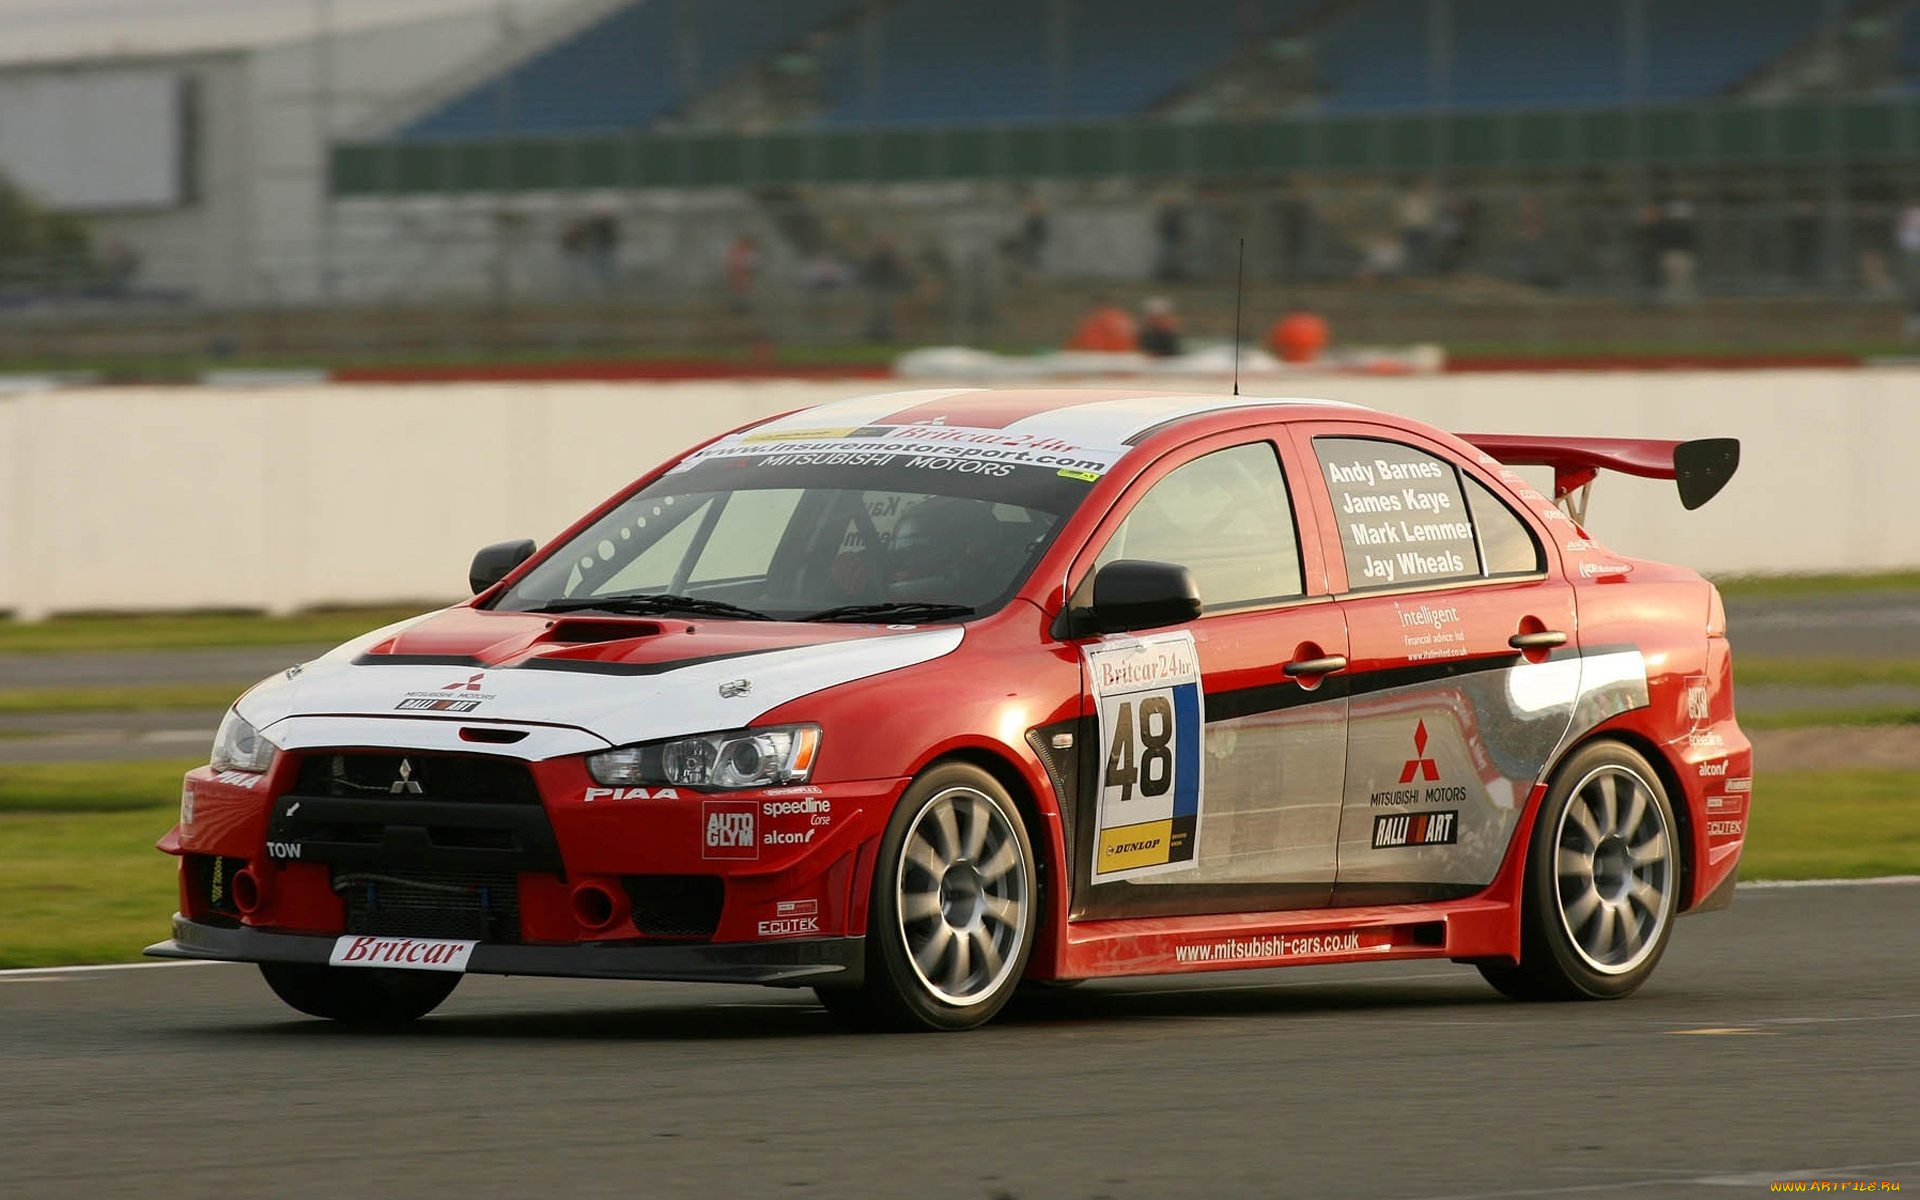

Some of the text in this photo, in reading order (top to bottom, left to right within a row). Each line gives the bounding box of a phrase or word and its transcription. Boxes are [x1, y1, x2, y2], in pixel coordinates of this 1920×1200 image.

[758, 455, 1016, 478] MITSUBISHI MOTORS
[1329, 460, 1442, 486] Andy Barnes
[1343, 489, 1450, 513] James Kaye
[1351, 520, 1473, 545] Mark Lemmer
[1364, 550, 1464, 581] Jay Wheals
[1394, 601, 1459, 629] intelligent
[1106, 696, 1173, 802] 48
[1699, 760, 1722, 776] alcon
[584, 788, 680, 801] PIAA
[1370, 786, 1467, 807] MITSUBISHI MOTORS
[763, 797, 831, 818] speedline
[707, 812, 754, 830] AUTO
[811, 814, 831, 826] Corse
[1376, 813, 1453, 846] RALLI ART
[707, 829, 754, 847] GLYM
[764, 830, 804, 844] alcon
[1115, 838, 1160, 854] DUNLOP
[266, 842, 301, 859] TOW
[758, 916, 820, 936] ECUTEK
[344, 937, 464, 964] Britcar
[1175, 930, 1359, 962] www.mitsubishi-cars.co.uk
